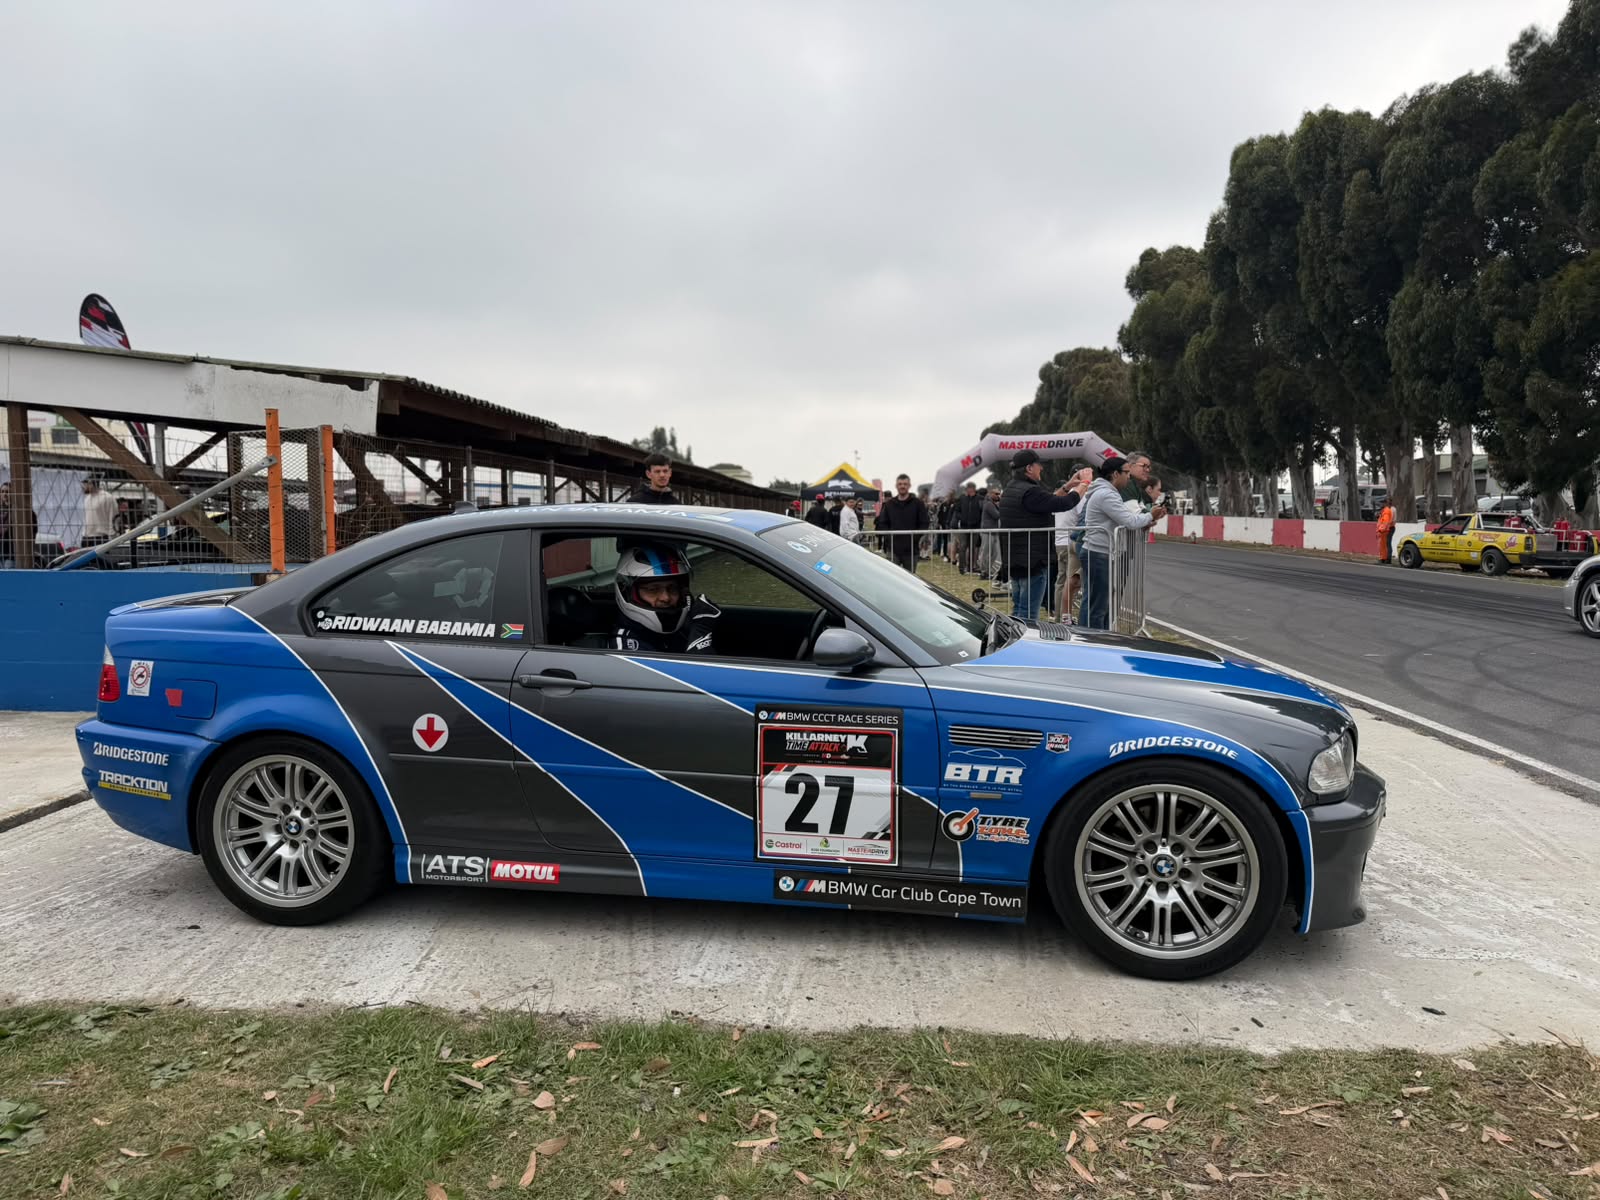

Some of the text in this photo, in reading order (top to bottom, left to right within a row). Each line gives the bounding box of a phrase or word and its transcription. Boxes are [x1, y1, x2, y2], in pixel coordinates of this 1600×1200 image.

[998, 438, 1084, 450] MASTERDRIVE
[960, 454, 983, 470] MD
[332, 616, 496, 638] RIDWAAN BABAMIA
[787, 712, 809, 721] BMW
[812, 713, 836, 723] CCCT
[838, 714, 863, 723] RACE
[865, 715, 899, 725] SERIES
[785, 732, 847, 742] KILLARNEY
[93, 742, 170, 766] BRIDGESTONE
[785, 741, 840, 752] TIME ATTACK
[1109, 736, 1239, 760] BRIDGESTONE
[944, 762, 1024, 784] BTR
[98, 770, 168, 793] TRACKTION
[785, 772, 855, 835] 27
[979, 816, 1028, 828] TYRE
[774, 841, 802, 849] Castrol
[847, 847, 889, 855] MASTERDRIVE
[426, 854, 485, 876] ATS
[494, 863, 555, 880] MOTUL
[425, 874, 484, 882] MOTORSPORT
[828, 881, 868, 896] BMW
[871, 884, 896, 899] Car
[900, 887, 934, 901] Club
[938, 889, 976, 906] Cape
[979, 892, 1022, 908] Town
